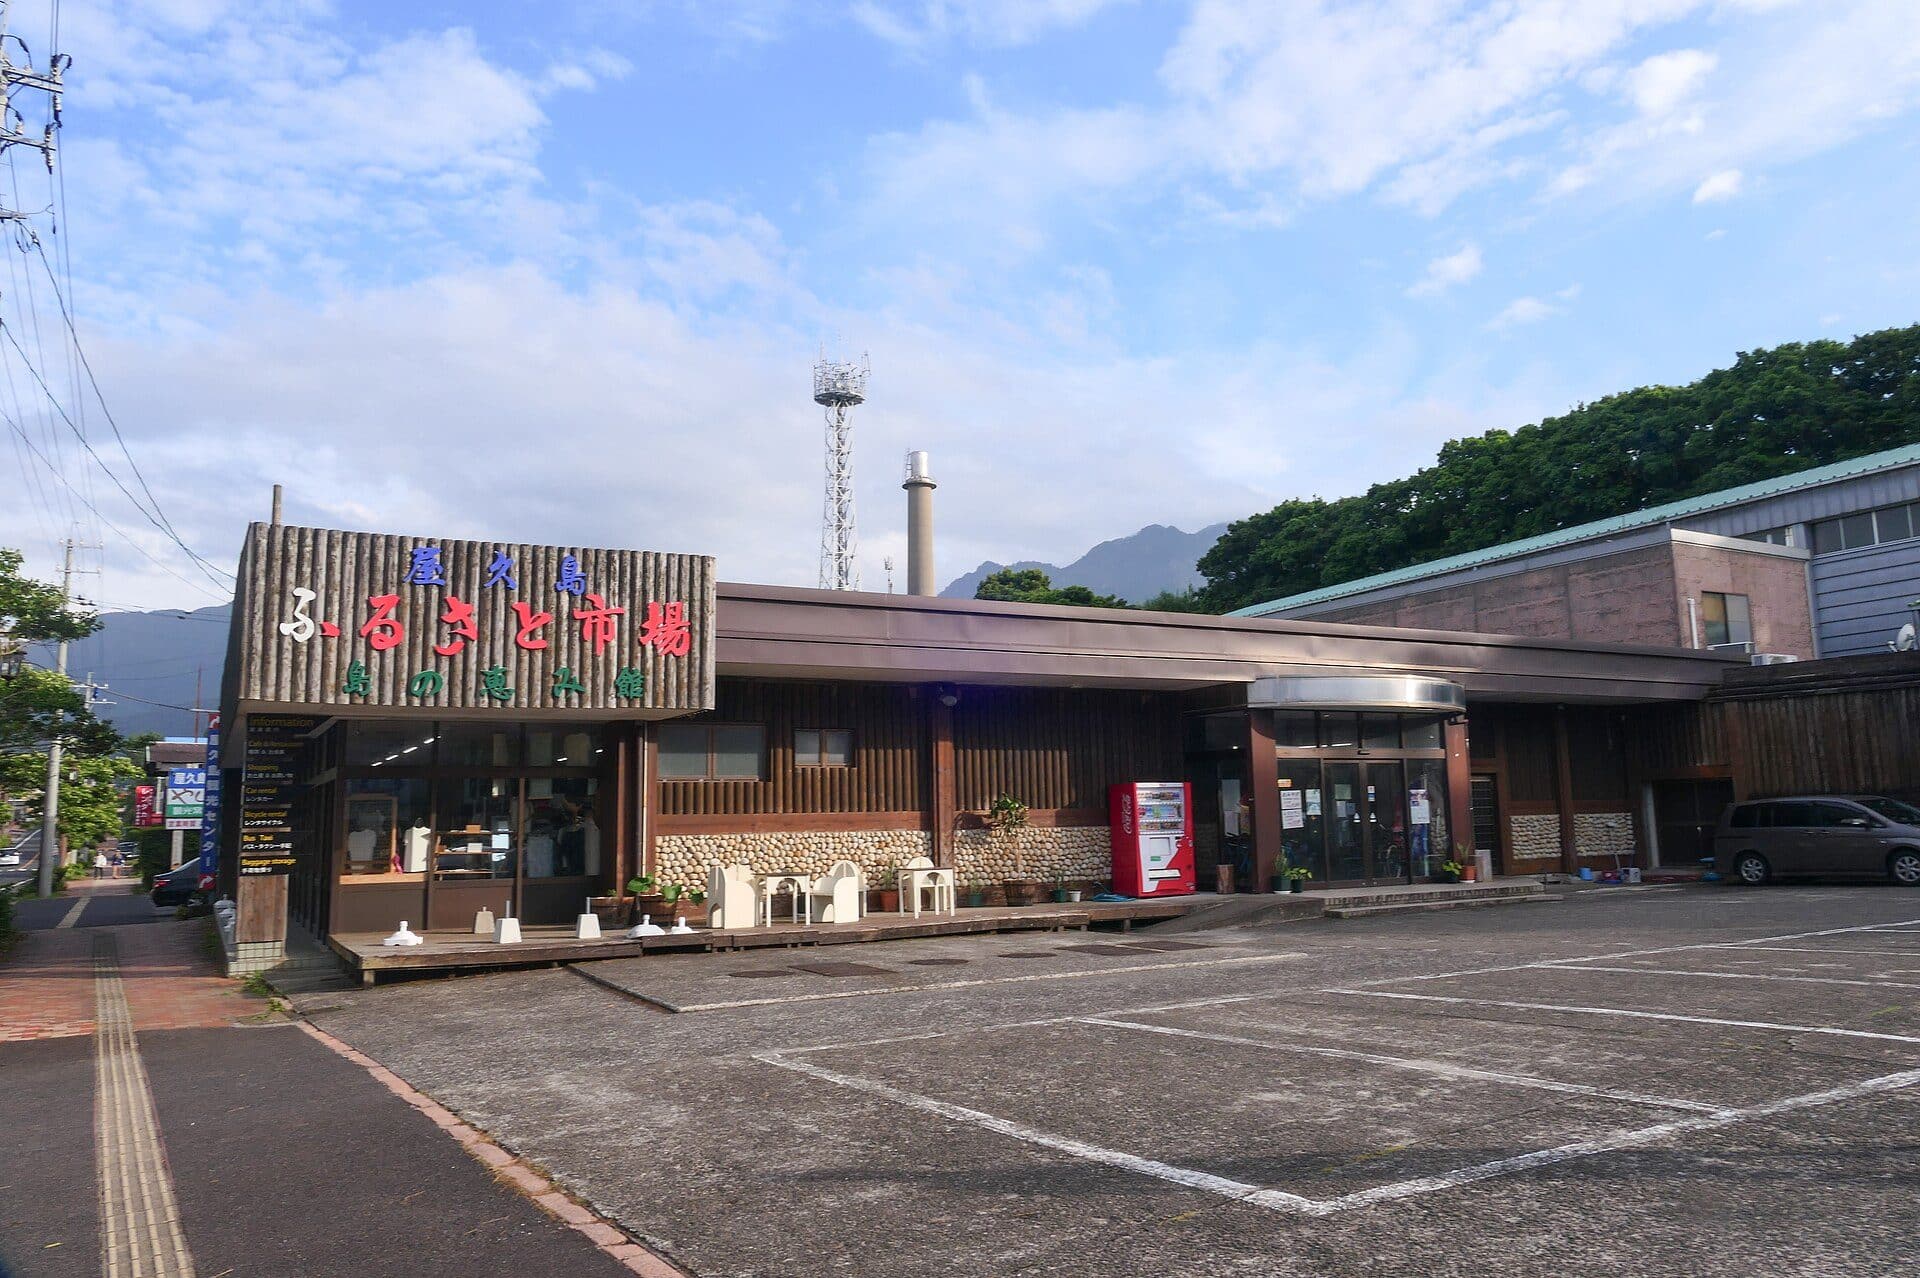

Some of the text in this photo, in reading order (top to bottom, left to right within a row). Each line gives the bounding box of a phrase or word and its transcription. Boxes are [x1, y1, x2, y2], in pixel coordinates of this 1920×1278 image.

[403, 547, 586, 596] 屋久島
[280, 588, 691, 657] ふるさと市場
[343, 659, 645, 701] 島の恵み館
